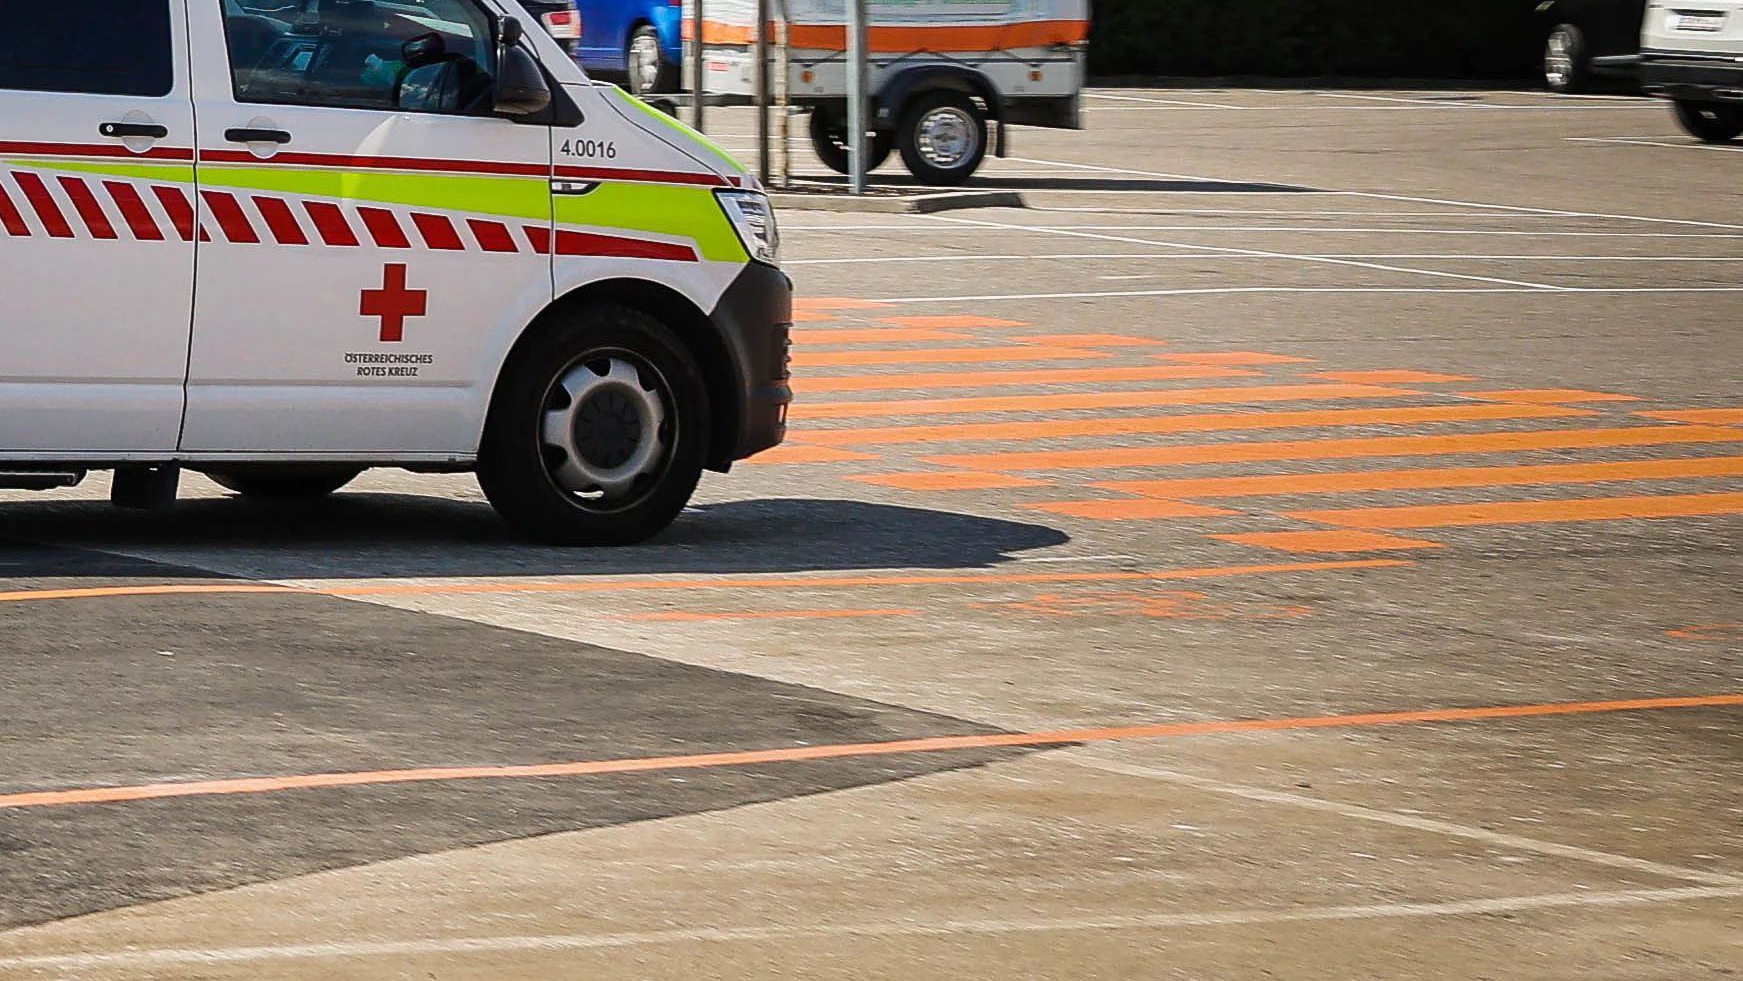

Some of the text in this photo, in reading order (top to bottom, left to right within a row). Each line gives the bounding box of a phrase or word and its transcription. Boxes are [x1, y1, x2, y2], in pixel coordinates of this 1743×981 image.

[560, 139, 616, 158] 4.0016
[344, 352, 434, 364] ÖSTERREICHISCHES
[356, 366, 418, 377] ROTES KREUZ
